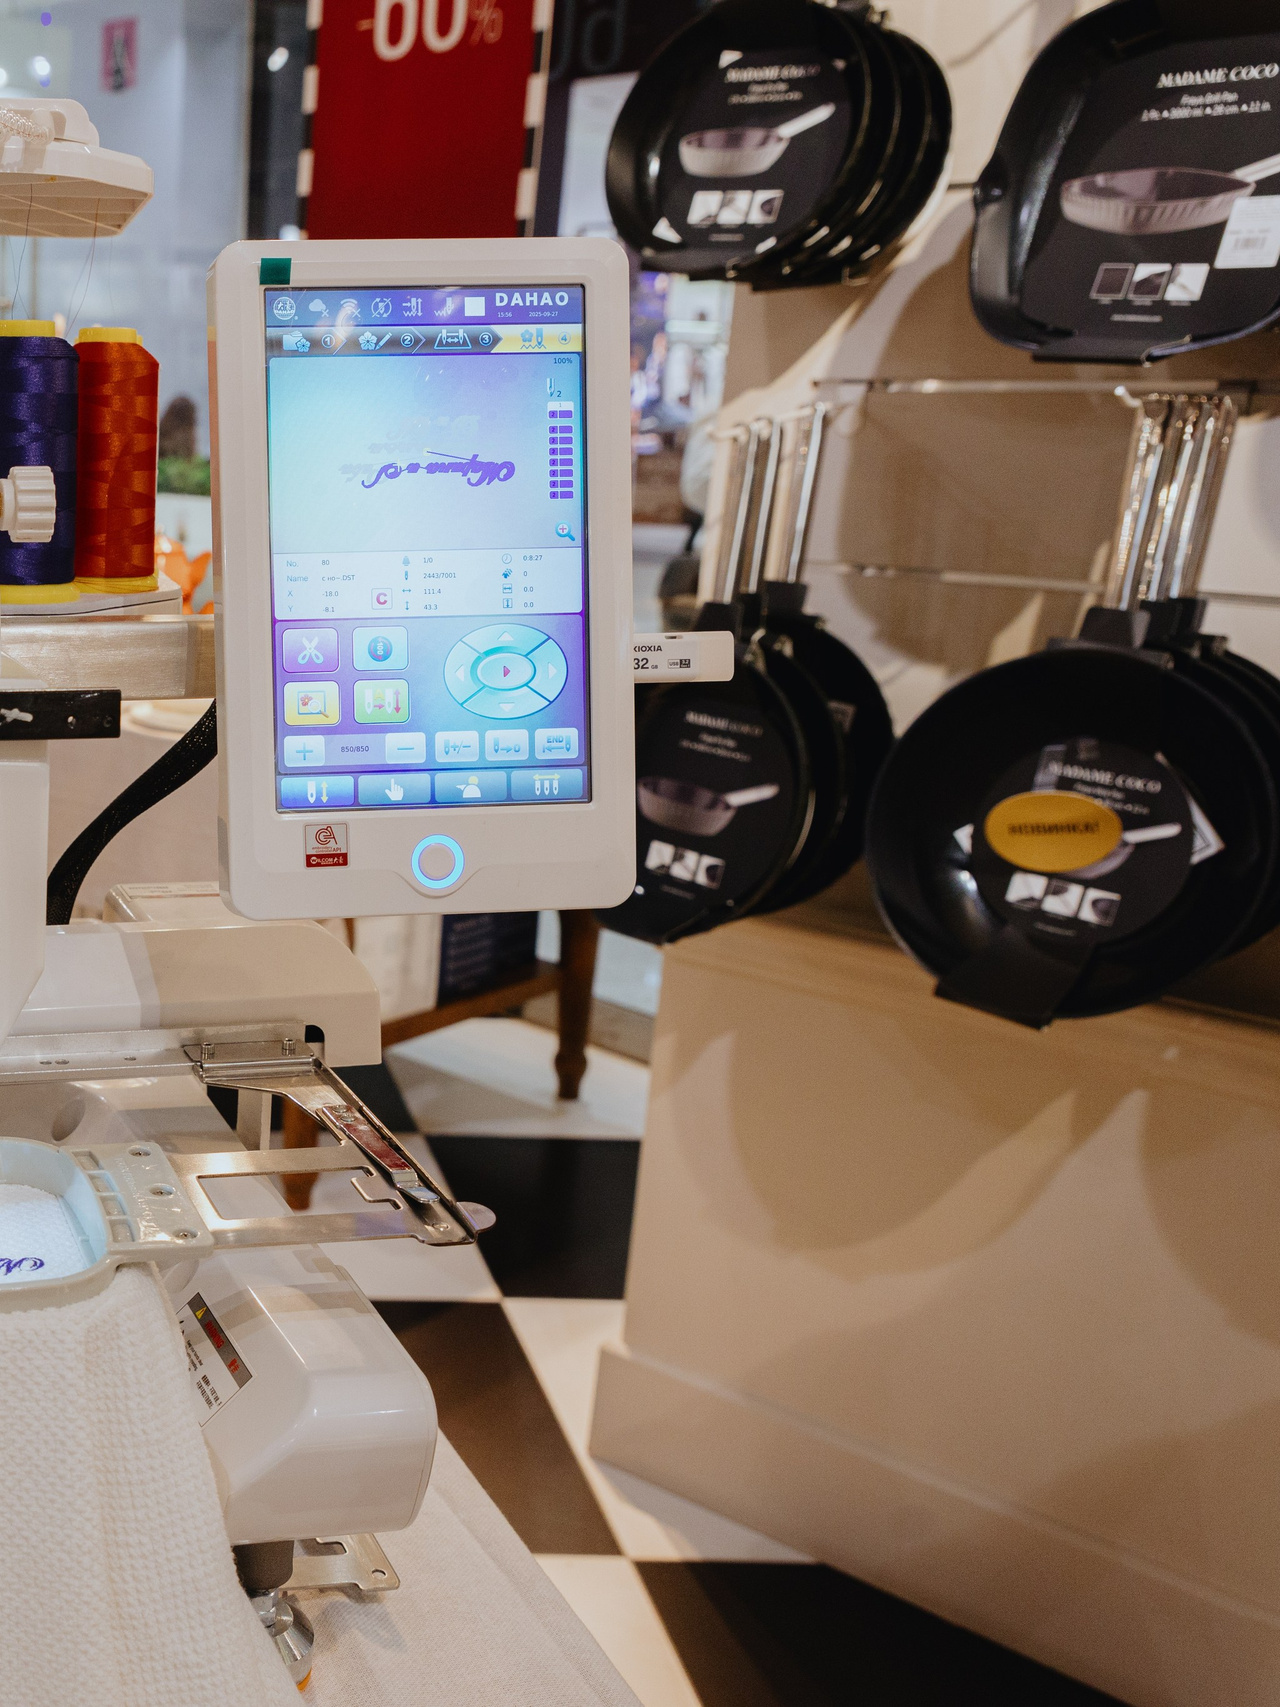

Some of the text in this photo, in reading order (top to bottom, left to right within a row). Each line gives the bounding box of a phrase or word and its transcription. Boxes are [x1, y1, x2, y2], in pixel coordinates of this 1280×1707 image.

[1156, 63, 1279, 88] MADAME COCO
[495, 291, 569, 307] DAHAO
[553, 357, 573, 365] 100%
[556, 390, 562, 398] 2
[633, 657, 649, 670] 32
[546, 735, 564, 744] END
[340, 745, 369, 753] 850/850
[204, 1320, 225, 1348] WARNING
